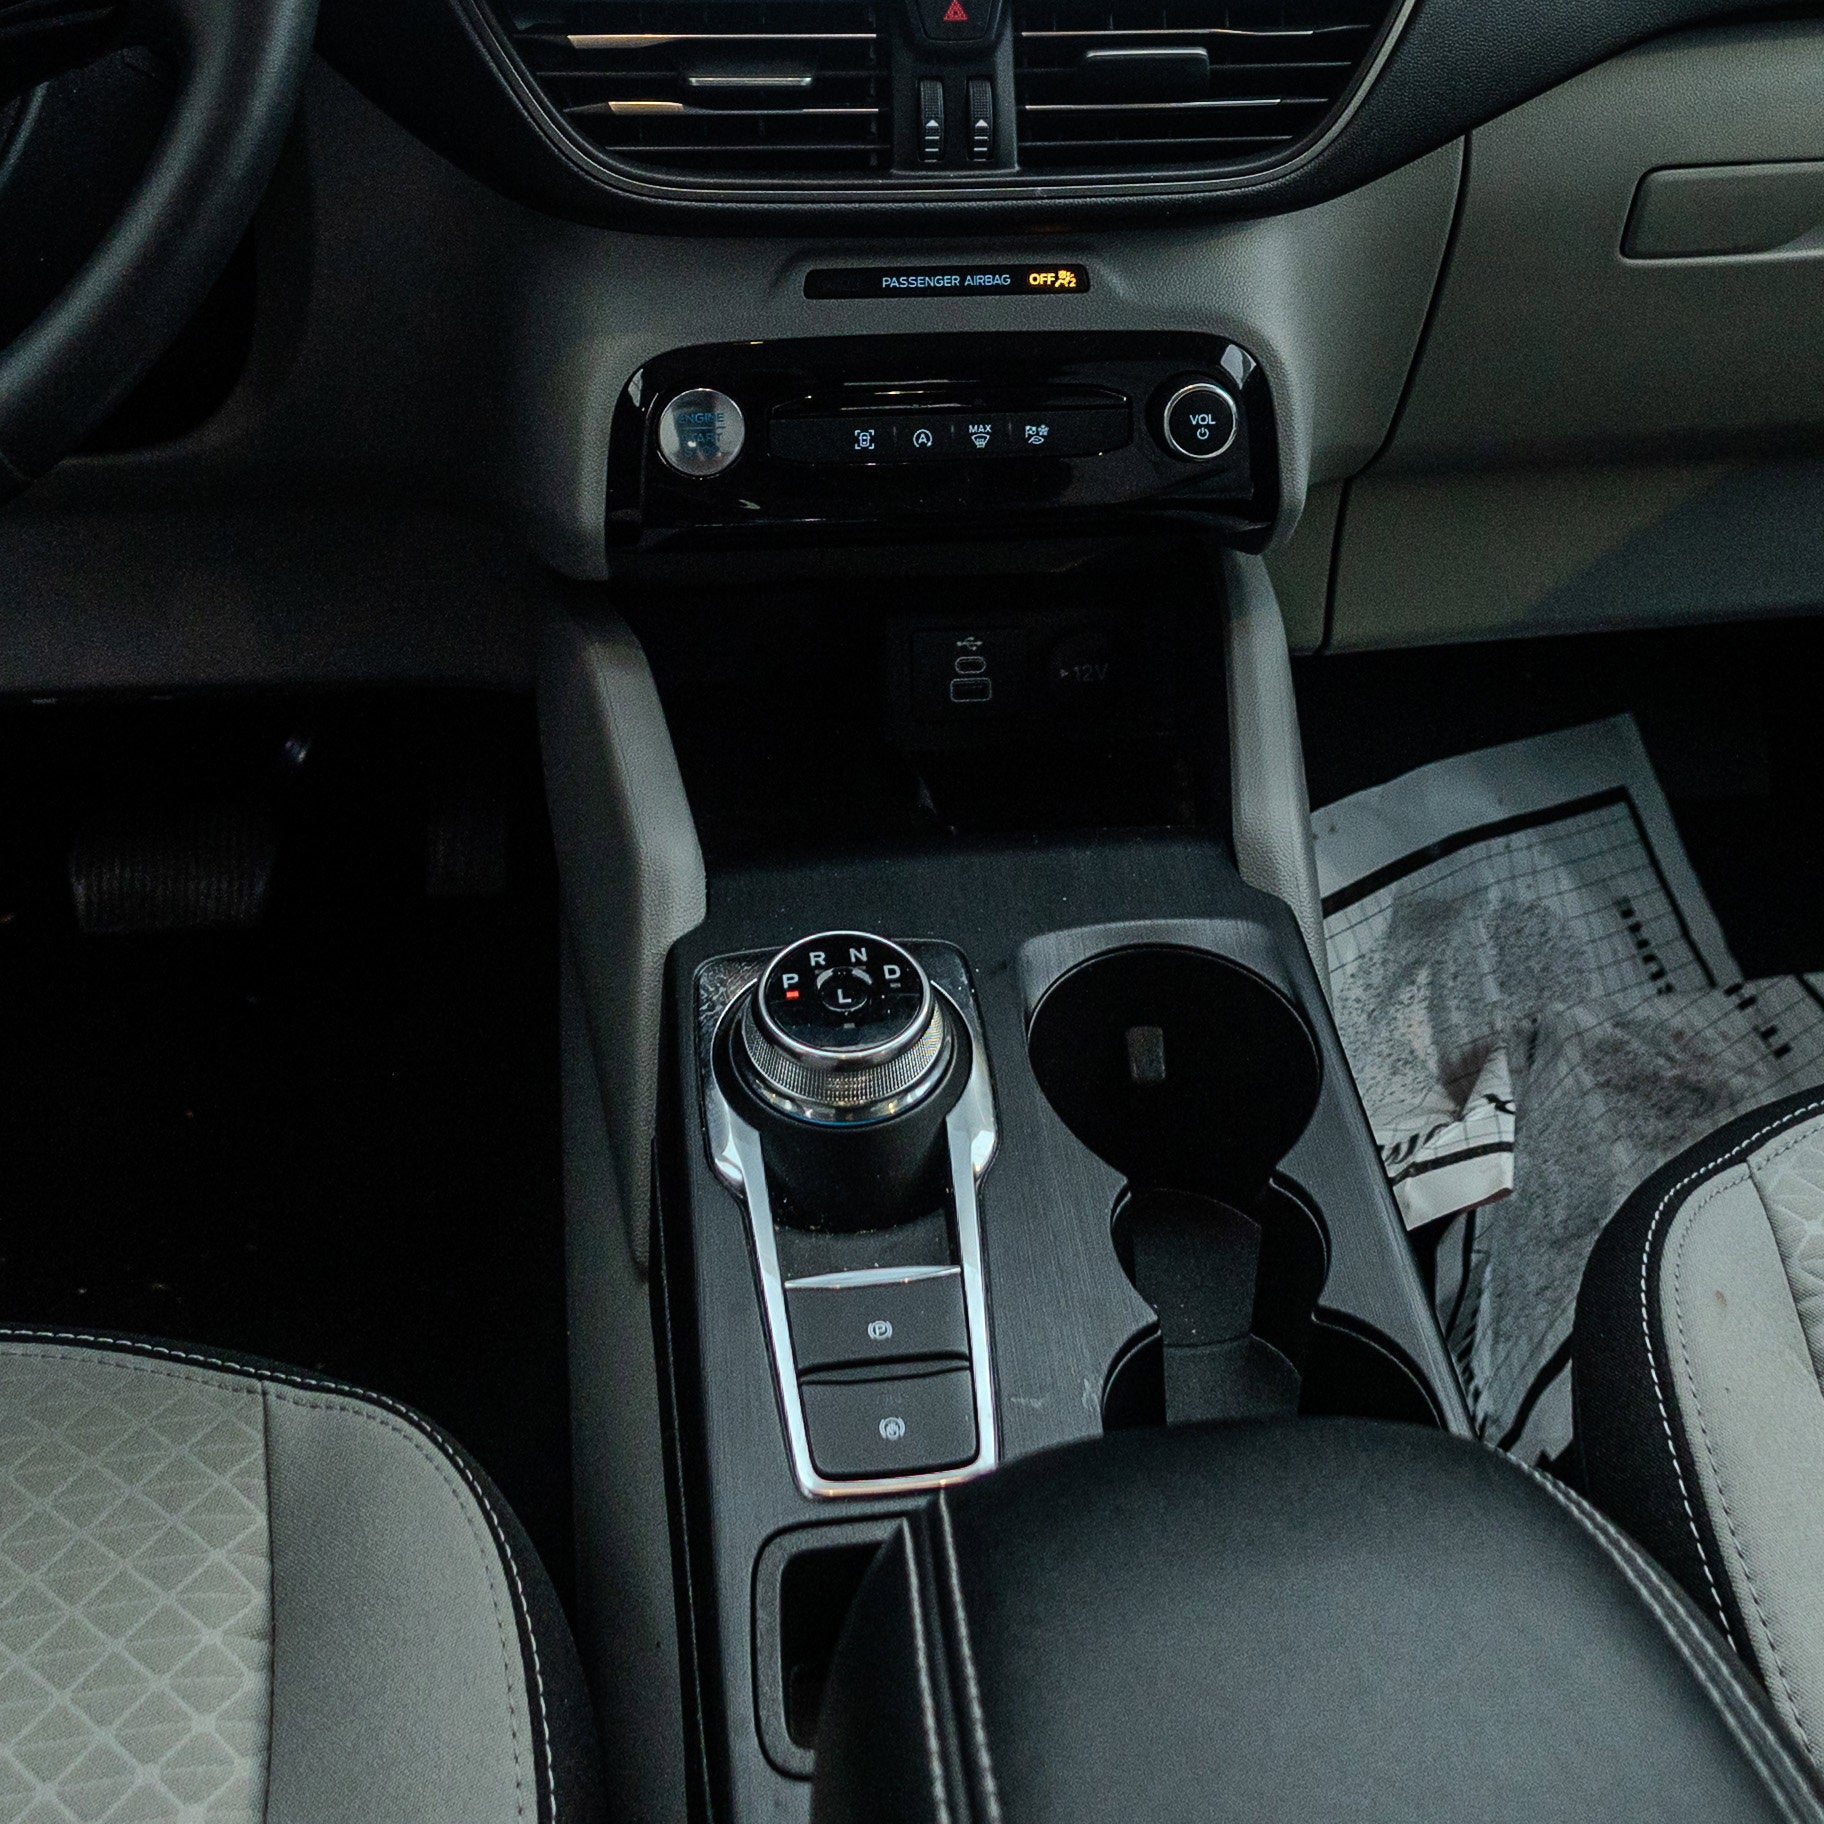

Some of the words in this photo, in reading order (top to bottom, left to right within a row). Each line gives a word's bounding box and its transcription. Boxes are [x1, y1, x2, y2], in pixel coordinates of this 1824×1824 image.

[882, 275, 960, 288] PASSENGER
[964, 274, 1011, 286] AIRBAG
[1029, 272, 1056, 285] OFF
[1189, 414, 1216, 425] VOL
[969, 424, 992, 434] MAX
[809, 951, 826, 966] R
[849, 947, 868, 963] N
[883, 964, 901, 980] D
[782, 973, 799, 989] P
[837, 989, 852, 1003] L
